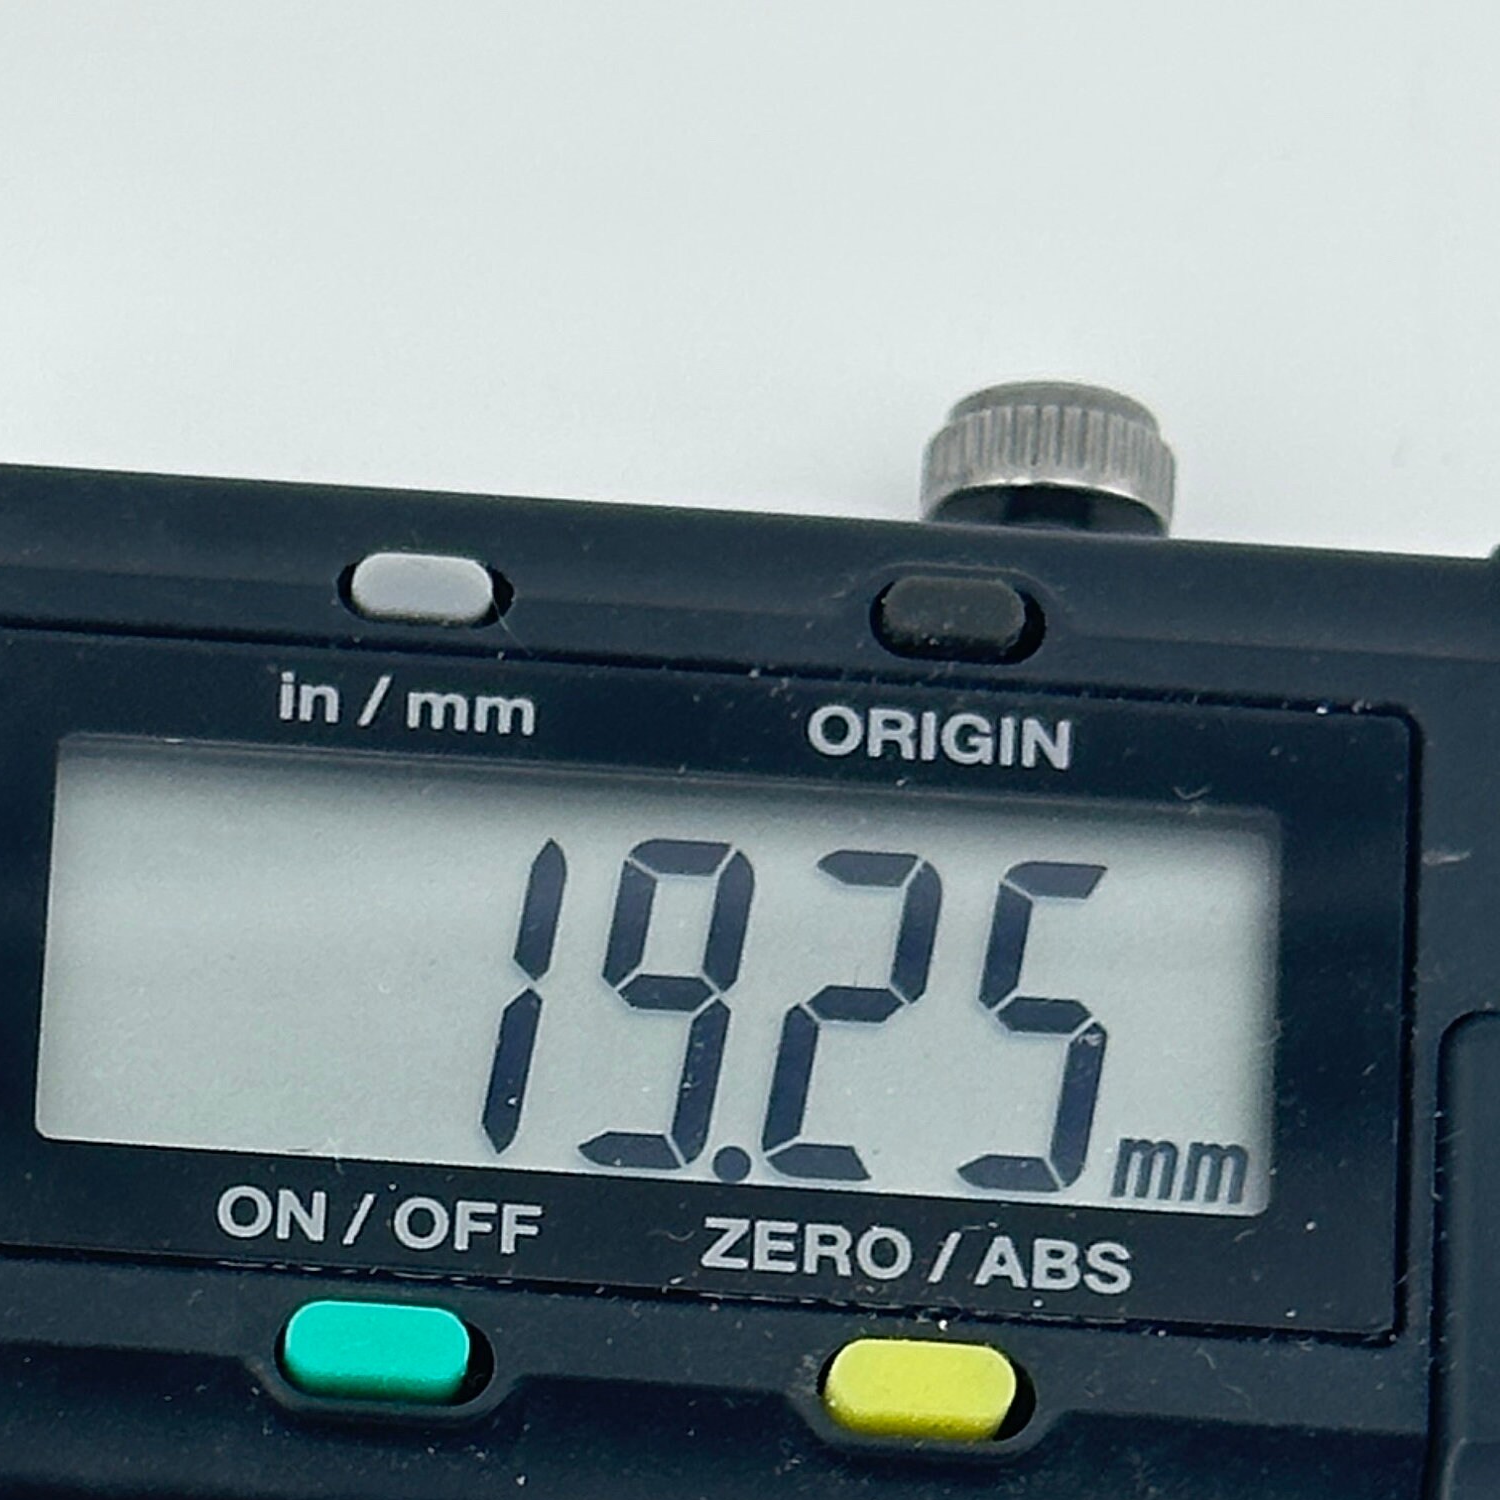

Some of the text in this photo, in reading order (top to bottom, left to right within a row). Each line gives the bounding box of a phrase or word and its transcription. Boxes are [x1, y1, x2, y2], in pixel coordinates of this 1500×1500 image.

[277, 670, 340, 724] in
[406, 689, 536, 736] mm
[806, 705, 1073, 771] ORIGIN
[481, 838, 1249, 1205] 19.25 mm
[215, 1184, 327, 1244] ON
[393, 1196, 543, 1254] OFF
[700, 1216, 914, 1284] ZERO
[973, 1236, 1134, 1295] ABS
